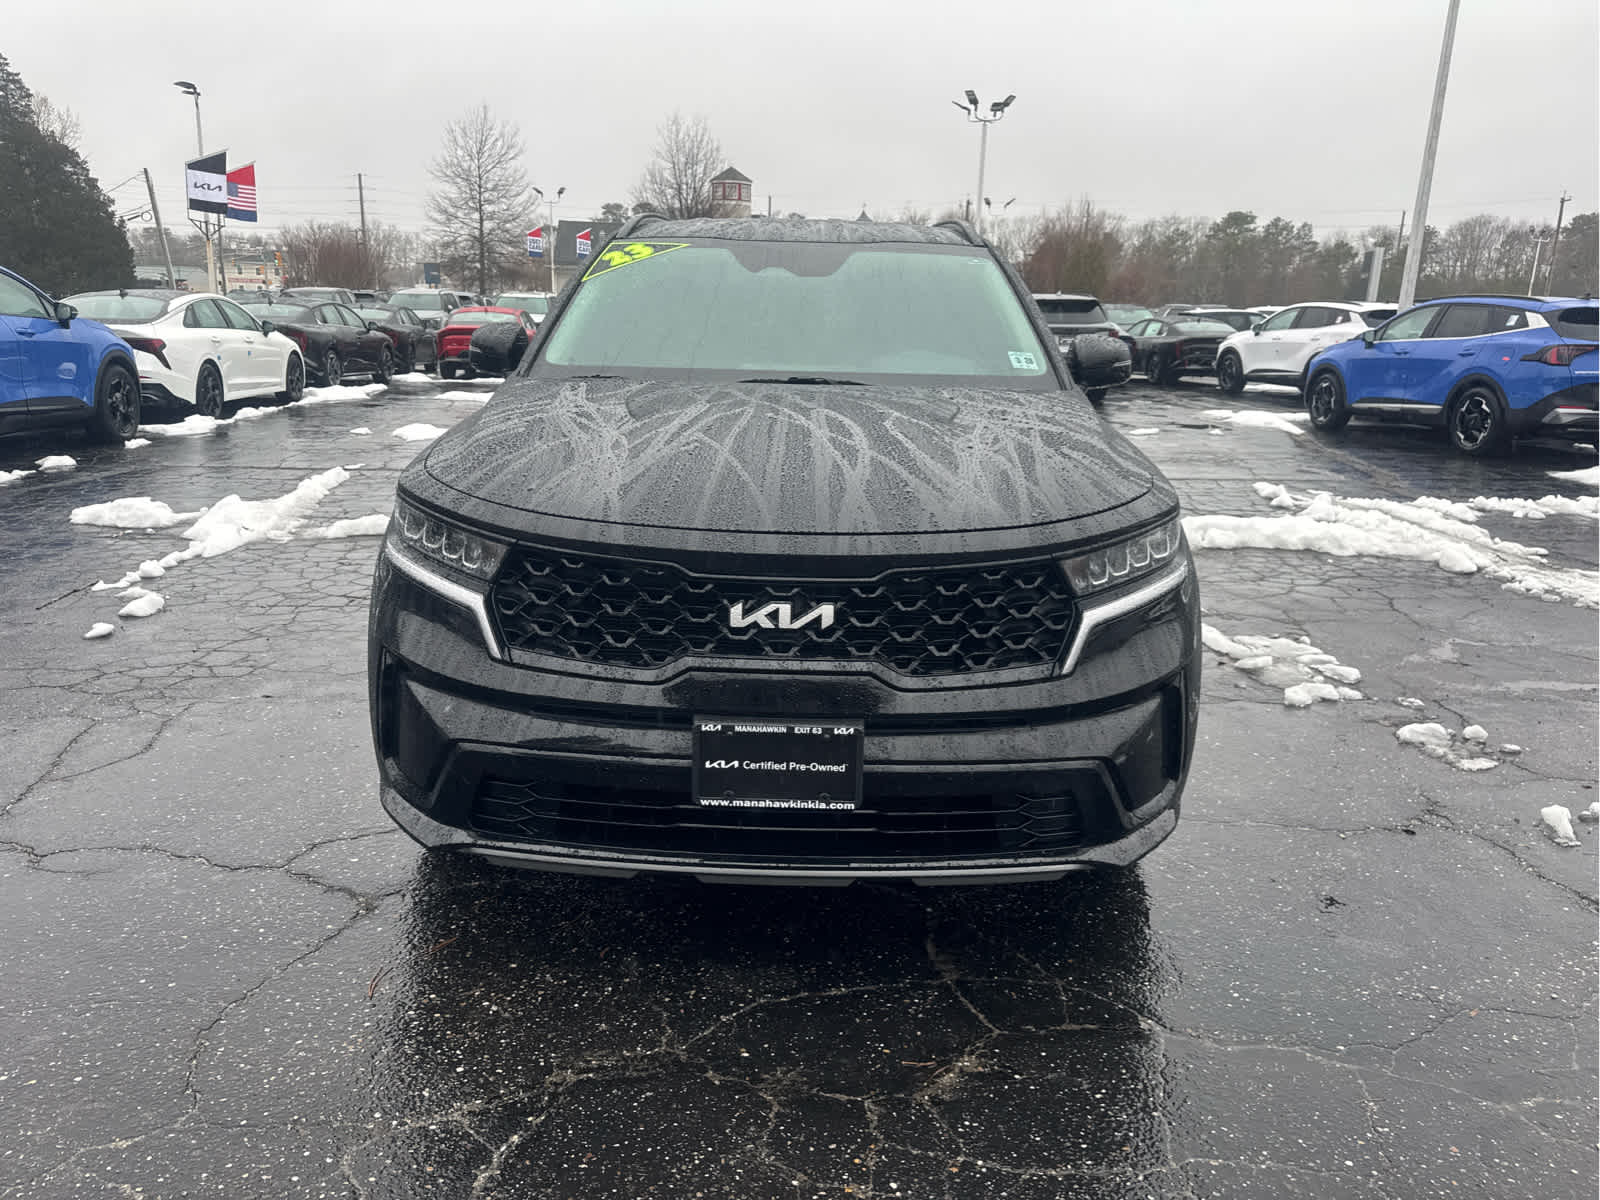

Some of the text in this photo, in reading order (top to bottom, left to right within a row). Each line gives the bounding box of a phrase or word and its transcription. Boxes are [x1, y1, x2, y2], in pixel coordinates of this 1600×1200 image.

[602, 242, 655, 266] 23
[729, 602, 835, 630] KIA
[701, 724, 722, 732] KIA
[735, 725, 787, 733] MANAHAWKIN
[812, 727, 822, 735] 63
[833, 727, 855, 735] KIA
[705, 760, 848, 773] KIA Certified Pre-Owned
[700, 799, 855, 810] www.manahawkinkia.com
